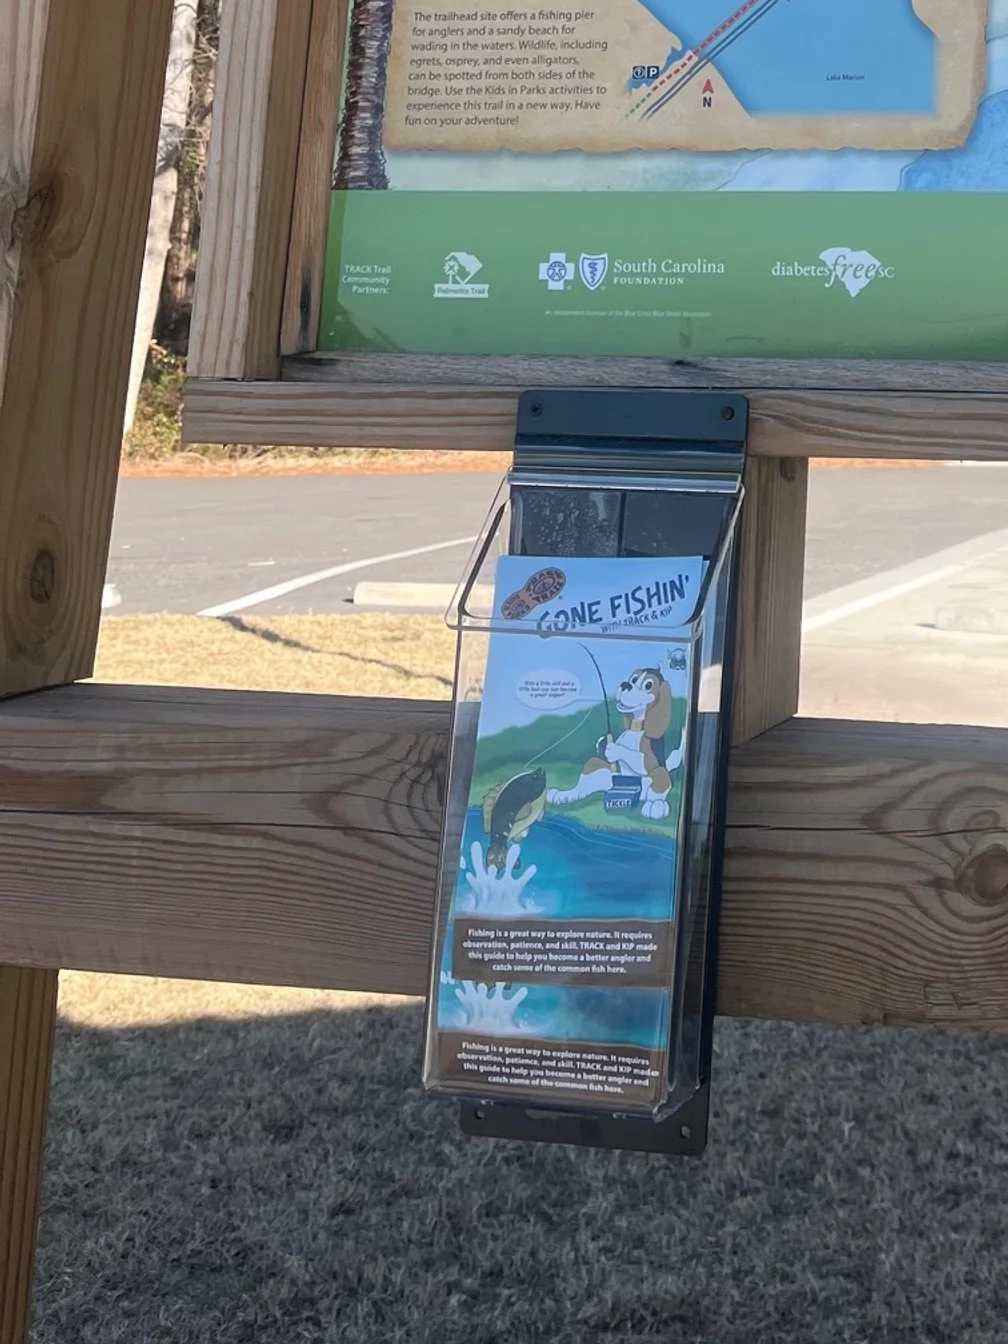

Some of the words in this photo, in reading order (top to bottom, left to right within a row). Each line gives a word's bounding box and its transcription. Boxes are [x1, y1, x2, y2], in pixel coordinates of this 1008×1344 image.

[703, 98, 712, 107] N
[404, 115, 421, 125] fun
[423, 117, 437, 125] on
[438, 117, 462, 127] your
[464, 115, 519, 125] adventure!
[344, 264, 372, 273] TRACK
[373, 264, 391, 273] Trail
[613, 258, 656, 272] South
[660, 258, 724, 272] Carolina
[341, 274, 390, 286] Community
[613, 276, 684, 284] FOUNDATION
[352, 284, 389, 294] Partners:
[537, 600, 602, 632] GONE
[610, 574, 689, 618] FISHIN'
[623, 613, 650, 626] TRACK
[659, 606, 672, 618] KIP
[468, 928, 494, 938] Fishing
[496, 929, 502, 937] is
[509, 930, 529, 938] great
[530, 931, 546, 939] way
[556, 929, 584, 939] explore
[613, 930, 620, 938] It
[621, 931, 652, 940] requires
